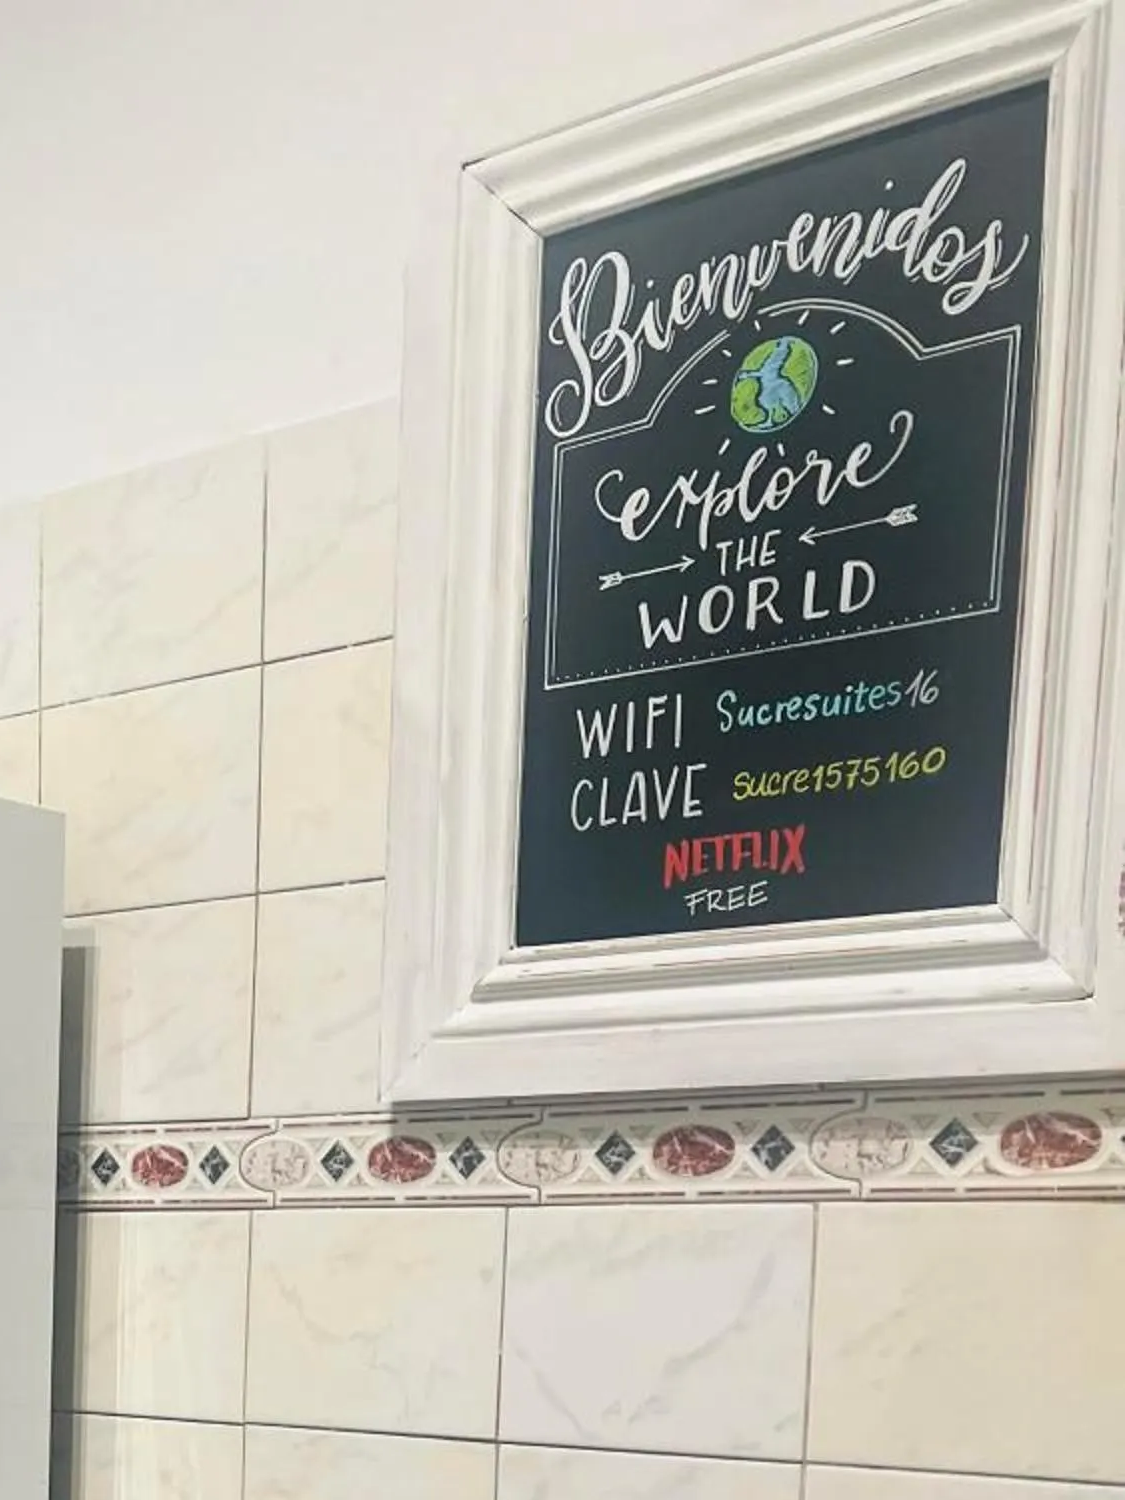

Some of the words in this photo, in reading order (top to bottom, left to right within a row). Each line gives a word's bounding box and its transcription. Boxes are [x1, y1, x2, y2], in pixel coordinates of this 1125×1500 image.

[545, 158, 1029, 438] Bienvenidos
[595, 410, 913, 551] explore
[717, 529, 781, 576] THE
[638, 560, 875, 649] WORLD
[576, 693, 683, 759] WIFI
[716, 669, 940, 733] Sucresuites16
[571, 763, 707, 831] CLAVE
[663, 824, 806, 889] NETFLIX
[685, 880, 769, 915] FREE
